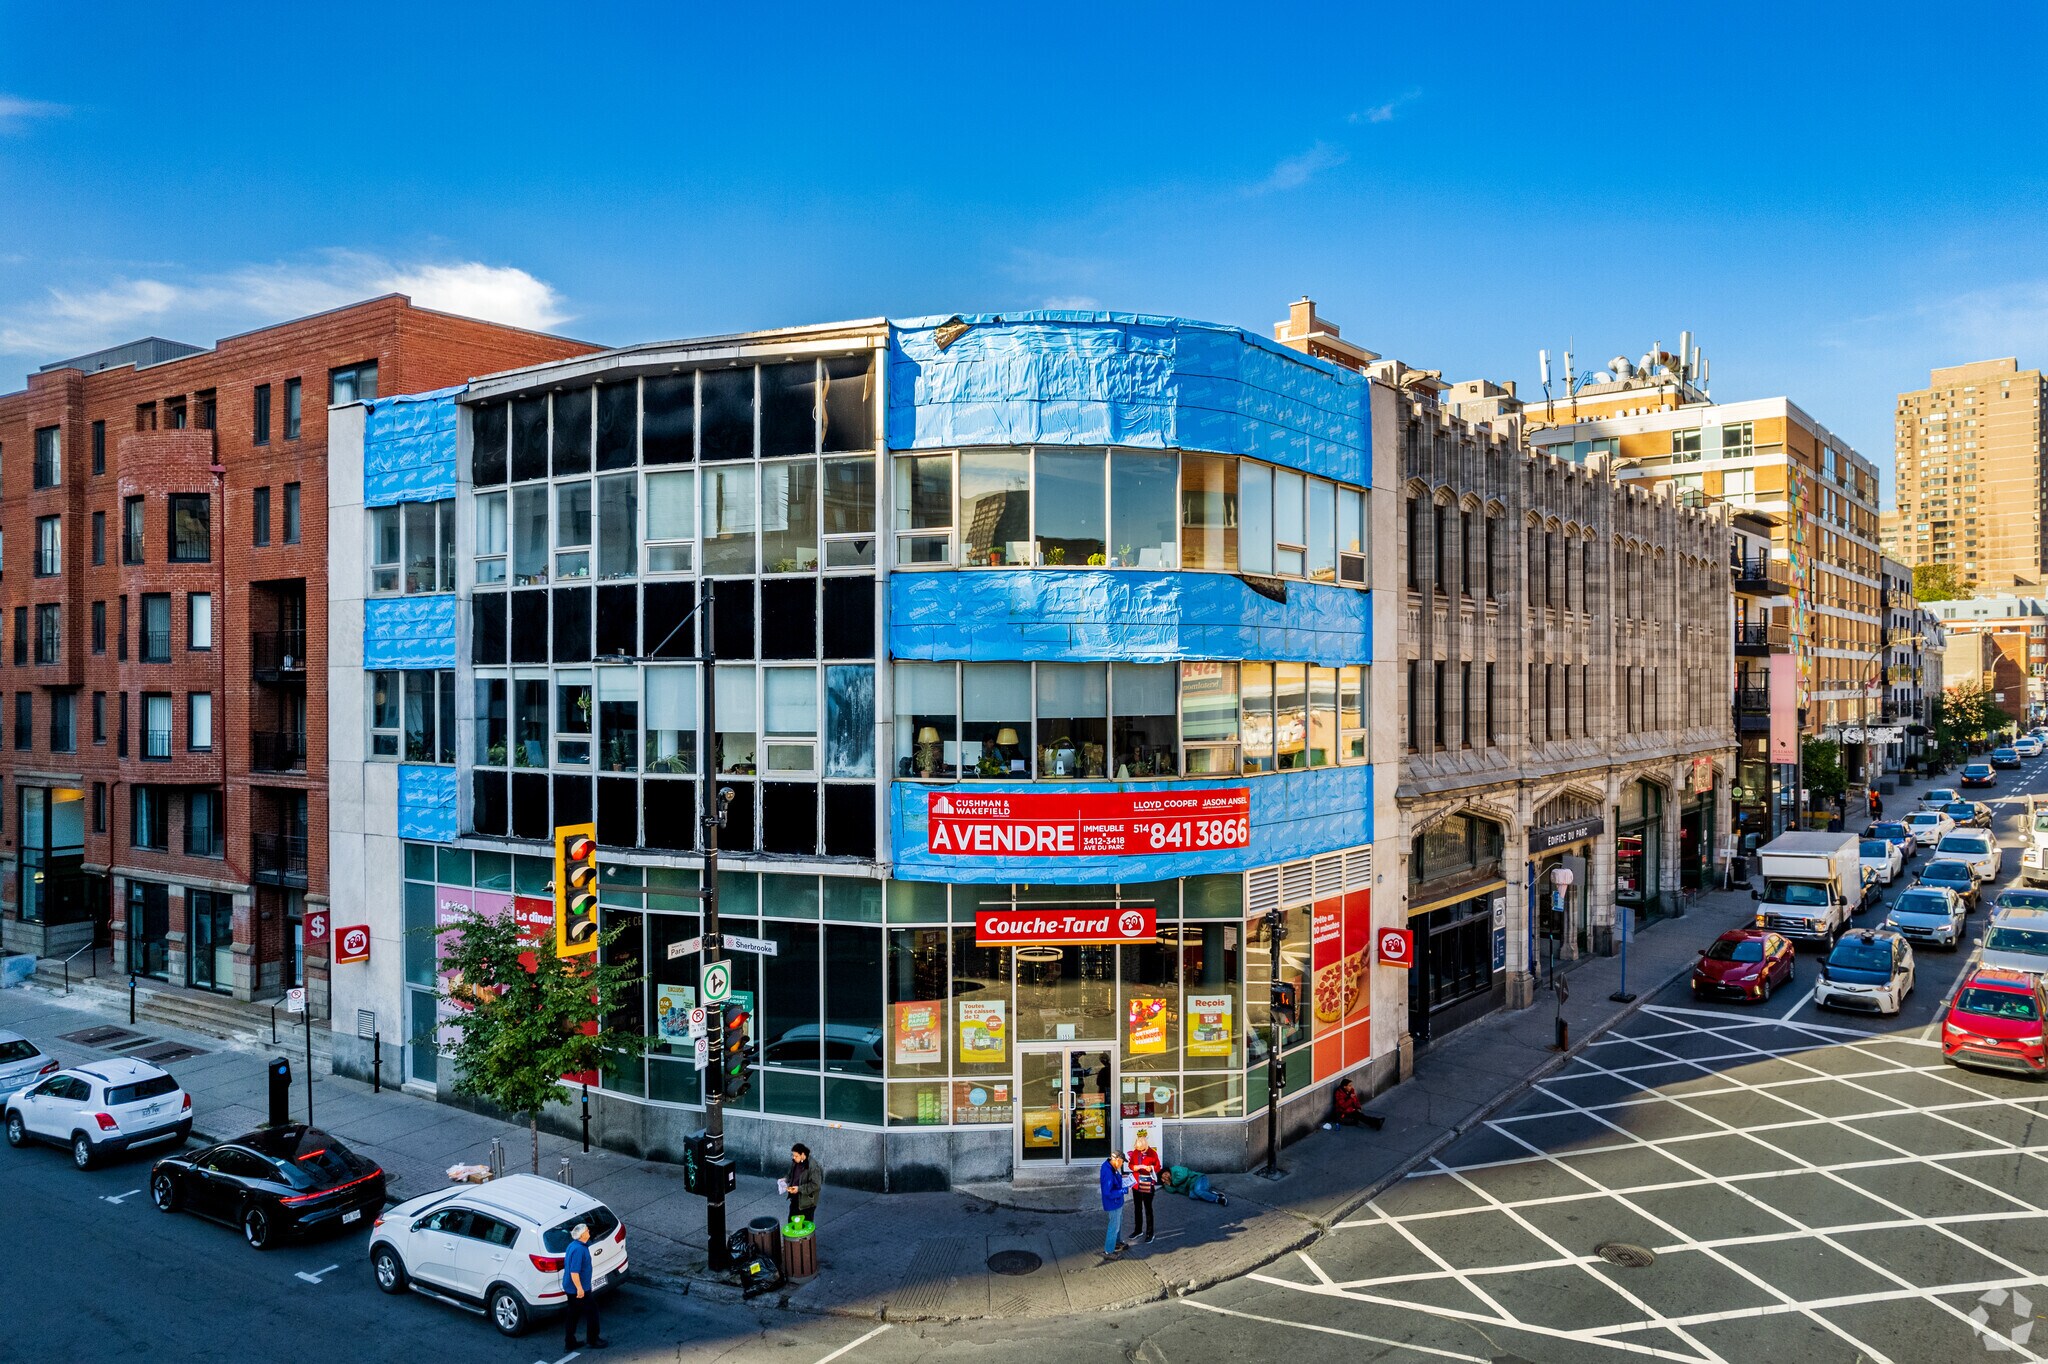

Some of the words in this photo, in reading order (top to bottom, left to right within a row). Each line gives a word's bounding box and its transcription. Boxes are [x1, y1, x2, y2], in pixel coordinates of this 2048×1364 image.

[1134, 800, 1161, 809] LLOYD
[1163, 799, 1198, 808] COOPER
[1202, 798, 1226, 807] JASON
[1228, 796, 1247, 805] ANSEL
[1083, 824, 1125, 833] IMMEUBLE
[1133, 824, 1149, 833] 514
[1150, 821, 1191, 849] 841
[1196, 817, 1247, 847] 3866
[932, 821, 952, 850] À
[952, 825, 1075, 851] VENDRE
[1083, 837, 1125, 845] 3412-3418
[1548, 833, 1566, 846] ÉDIFICE
[1568, 831, 1575, 840] DU
[1576, 827, 1587, 838] PARC
[516, 910, 527, 921] Le
[529, 911, 553, 924] dîner
[1314, 916, 1327, 925] Prête
[985, 917, 1109, 934] Couche-Tard
[1320, 922, 1340, 933] minutes
[671, 948, 685, 956] Parc
[736, 941, 772, 952] Sherbrooke
[1195, 1000, 1225, 1008] Reçois
